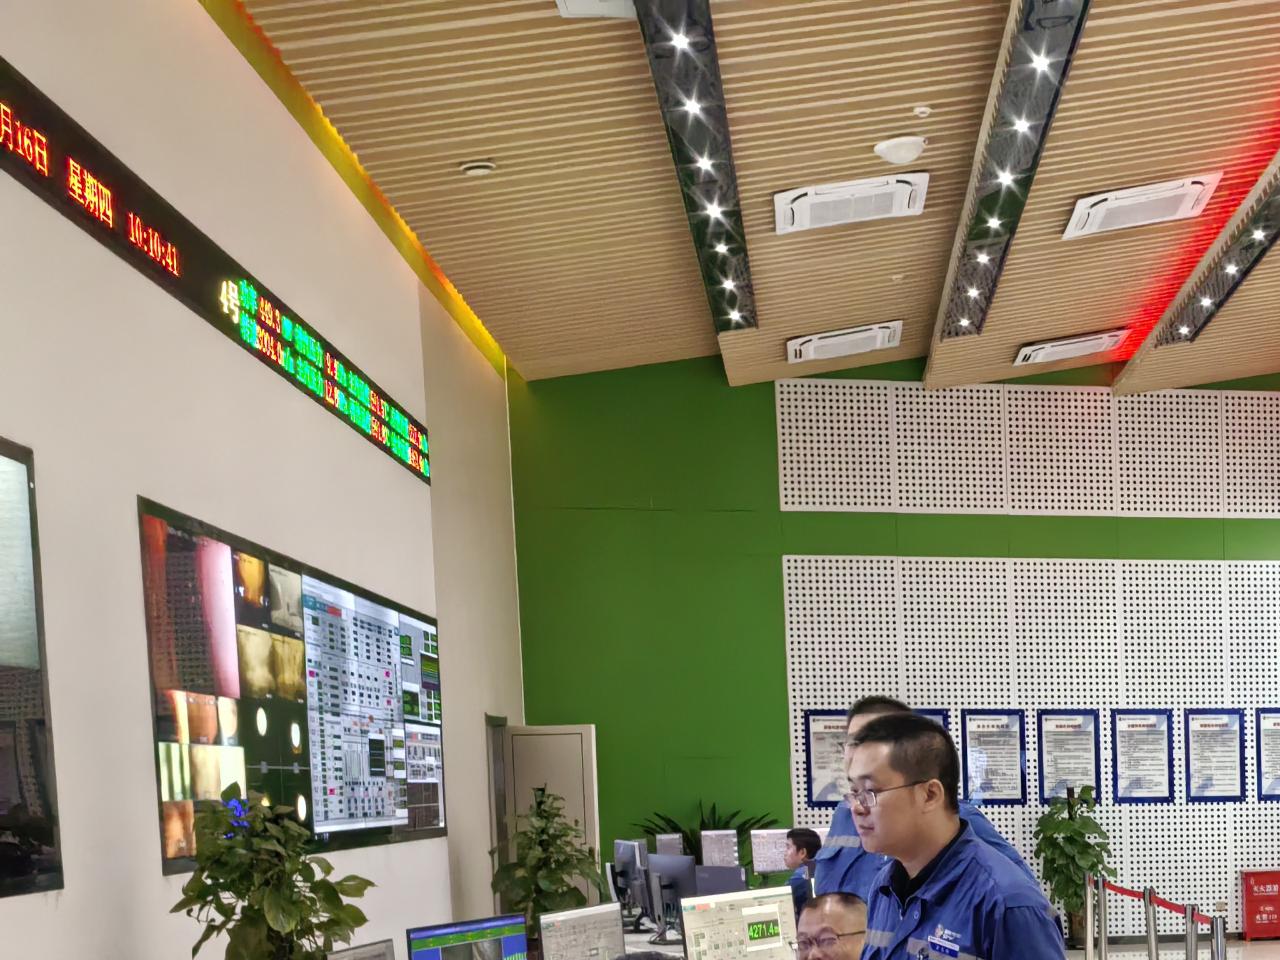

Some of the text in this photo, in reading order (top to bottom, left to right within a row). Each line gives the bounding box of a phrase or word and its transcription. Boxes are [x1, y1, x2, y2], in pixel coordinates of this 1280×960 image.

[68, 157, 113, 228] 星期四
[128, 212, 179, 277] 10:10:41
[220, 280, 240, 324] 4号
